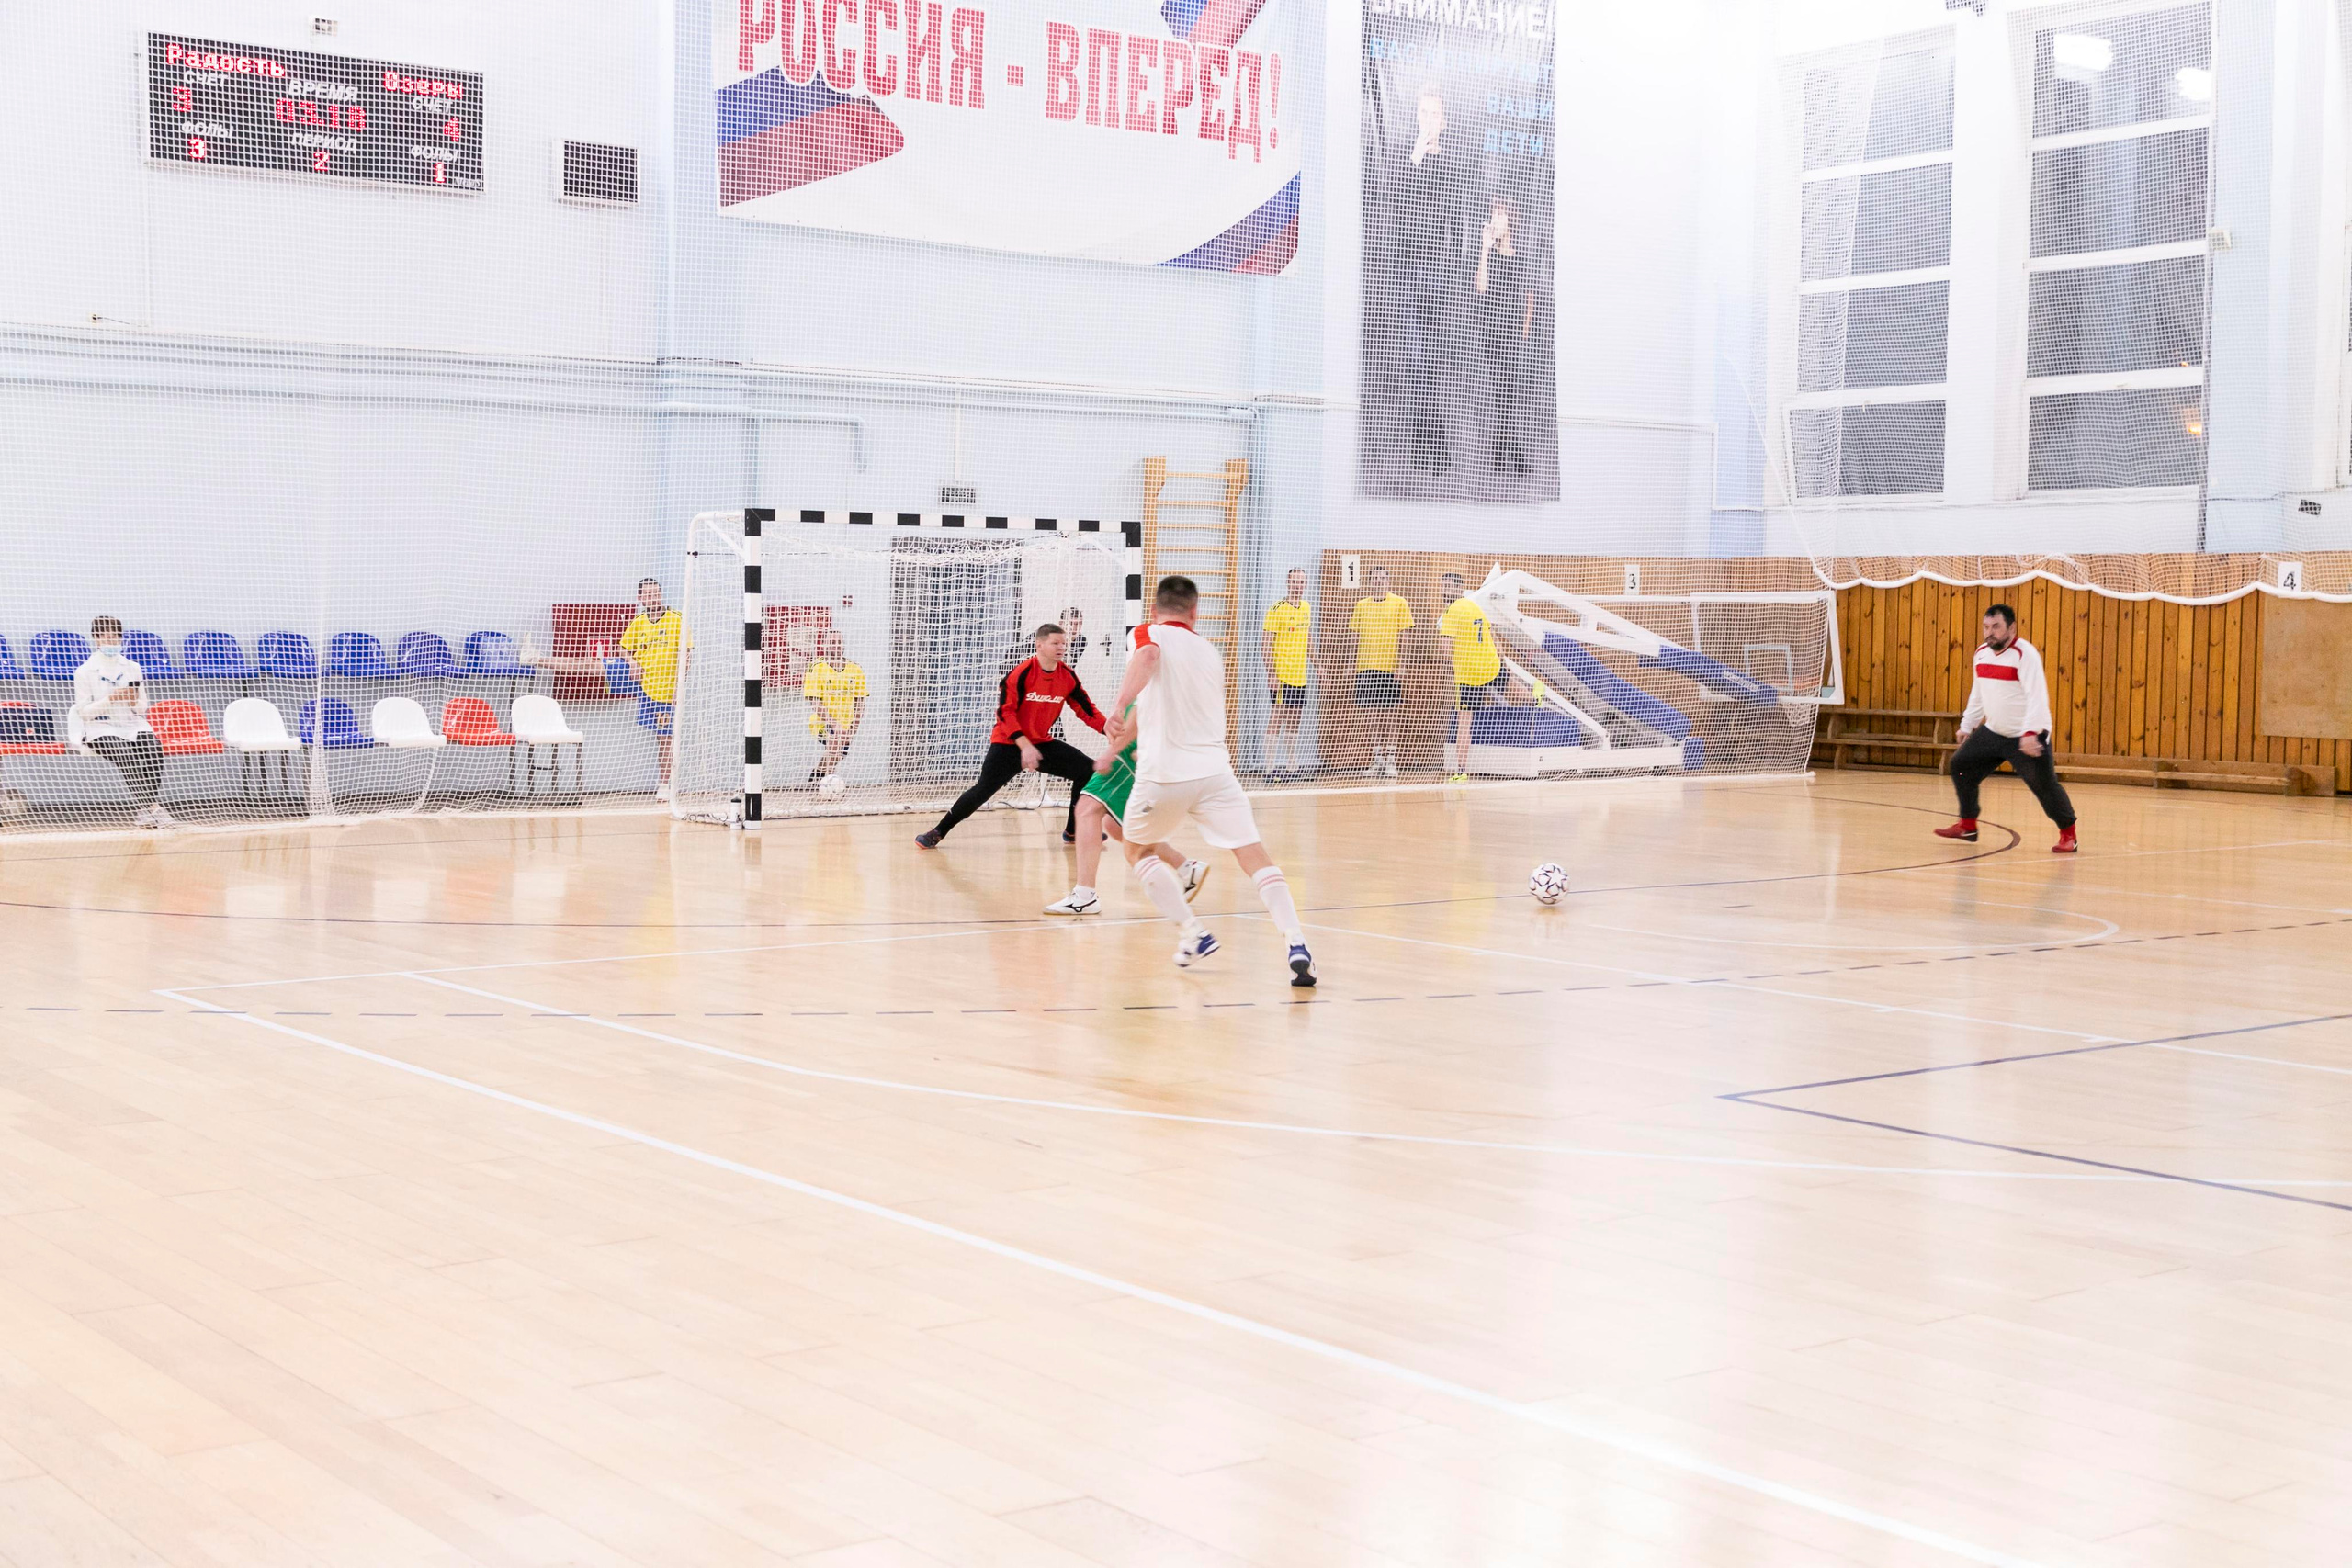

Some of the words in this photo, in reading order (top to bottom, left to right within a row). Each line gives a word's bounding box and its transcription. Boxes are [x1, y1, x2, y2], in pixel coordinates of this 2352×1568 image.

[166, 43, 285, 77] Радость
[184, 71, 228, 87] СЧЕТ
[738, 0, 984, 109] РОССИЯ
[1046, 21, 1281, 163] ВПЕРЕД!
[288, 79, 358, 102] ВРЕМЯ
[188, 137, 207, 159] 3
[291, 132, 356, 155] ПЕРИОД
[1482, 129, 1544, 157] ДЕТИ
[313, 151, 330, 172] 2
[433, 162, 447, 184] 1
[1628, 573, 1636, 590] 3
[2283, 570, 2296, 590] 4
[1473, 618, 1483, 643] 7
